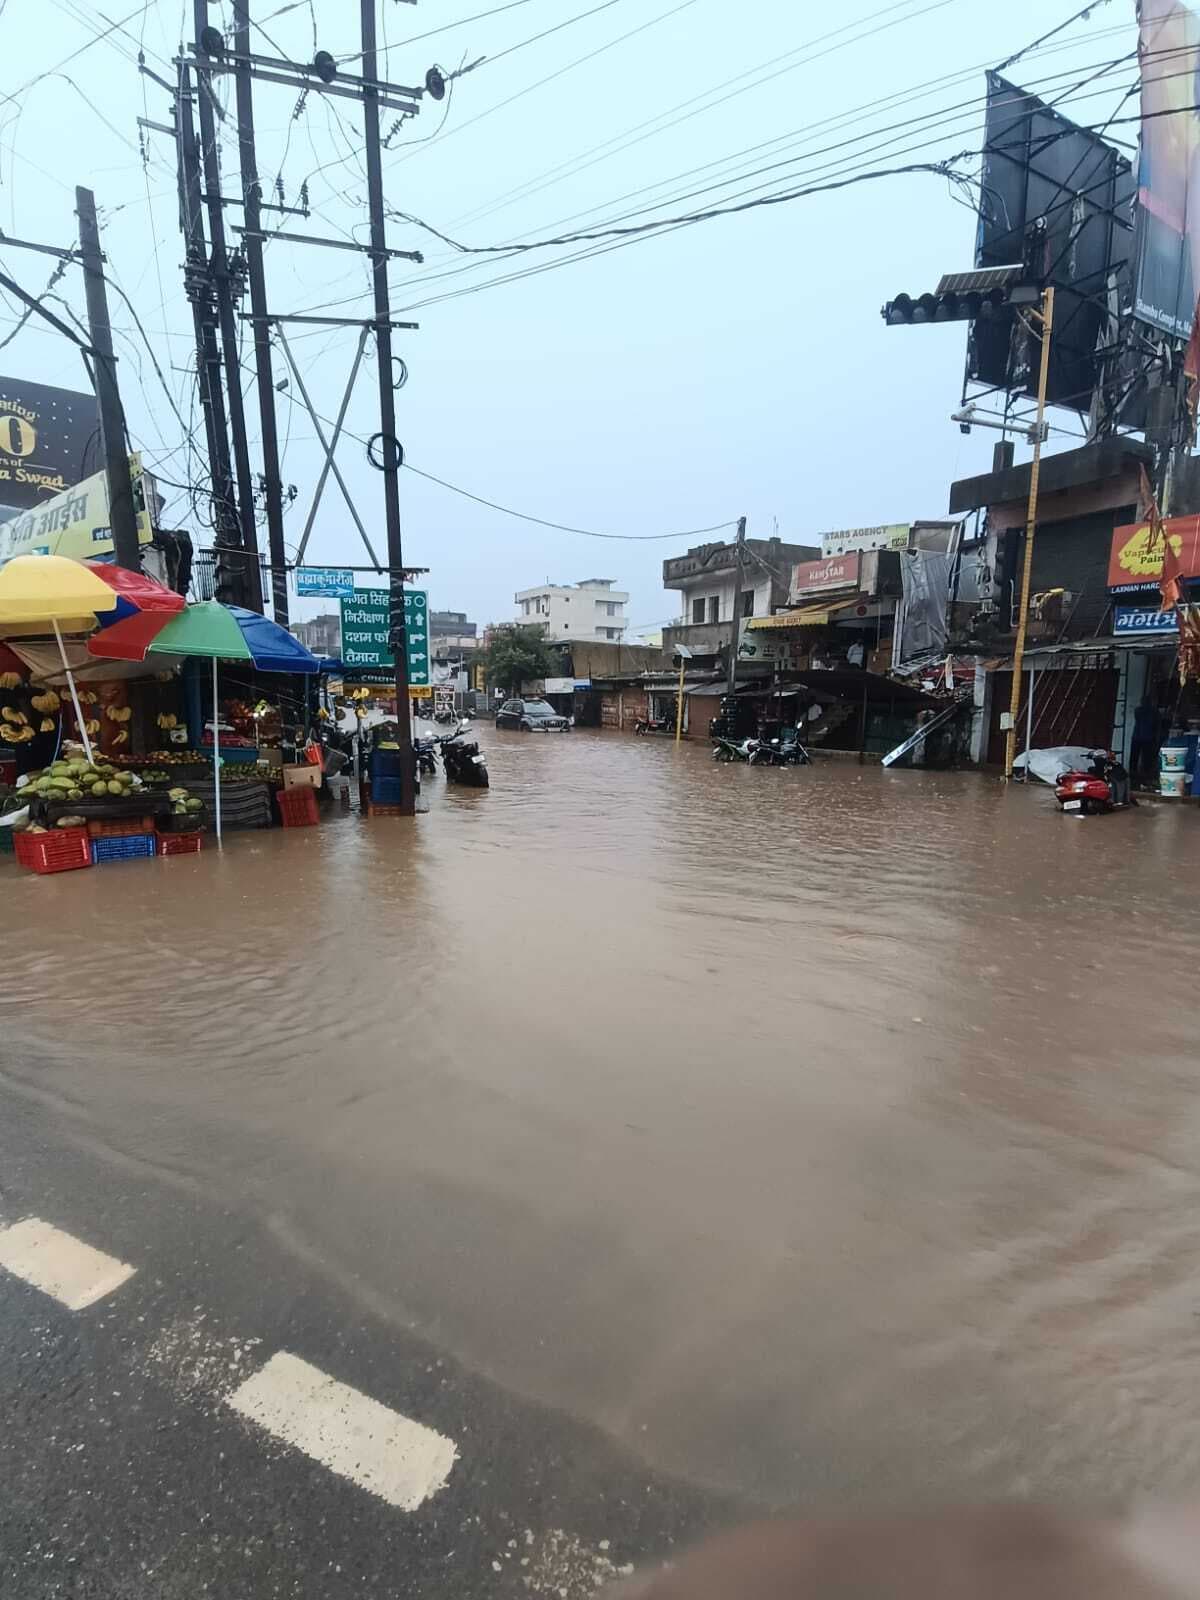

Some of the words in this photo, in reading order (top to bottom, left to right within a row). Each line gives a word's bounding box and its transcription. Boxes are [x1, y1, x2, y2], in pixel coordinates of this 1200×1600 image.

[15, 469, 67, 487] Swad
[852, 526, 888, 537] AGENCY
[1140, 554, 1165, 565] Pain
[1111, 584, 1139, 594] LAXMAN
[344, 609, 385, 625] निरीक्षण
[345, 631, 372, 643] दशम
[374, 629, 390, 644] फॉ
[345, 650, 380, 662] तैमारा
